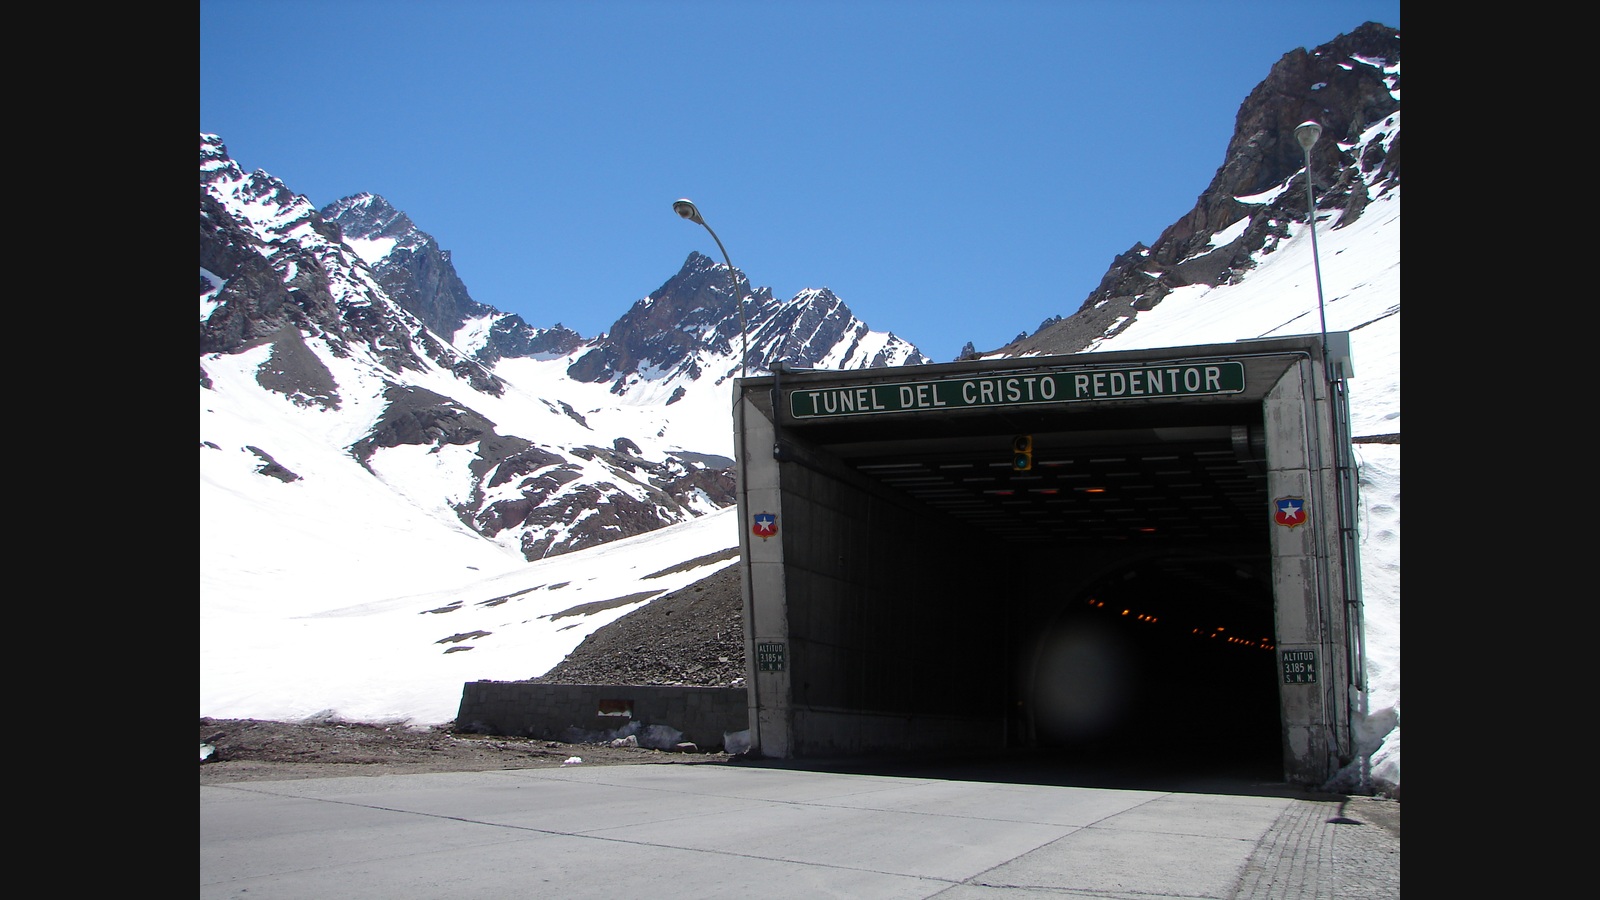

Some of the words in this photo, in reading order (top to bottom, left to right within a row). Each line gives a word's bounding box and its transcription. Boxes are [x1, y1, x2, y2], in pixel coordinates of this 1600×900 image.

[809, 388, 885, 414] TUNEL
[900, 384, 946, 409] DEL
[962, 376, 1056, 404] CRISTO
[1074, 366, 1221, 398] REDENTOR
[1284, 652, 1314, 661] ALTITUD
[1285, 662, 1305, 673] 3.185
